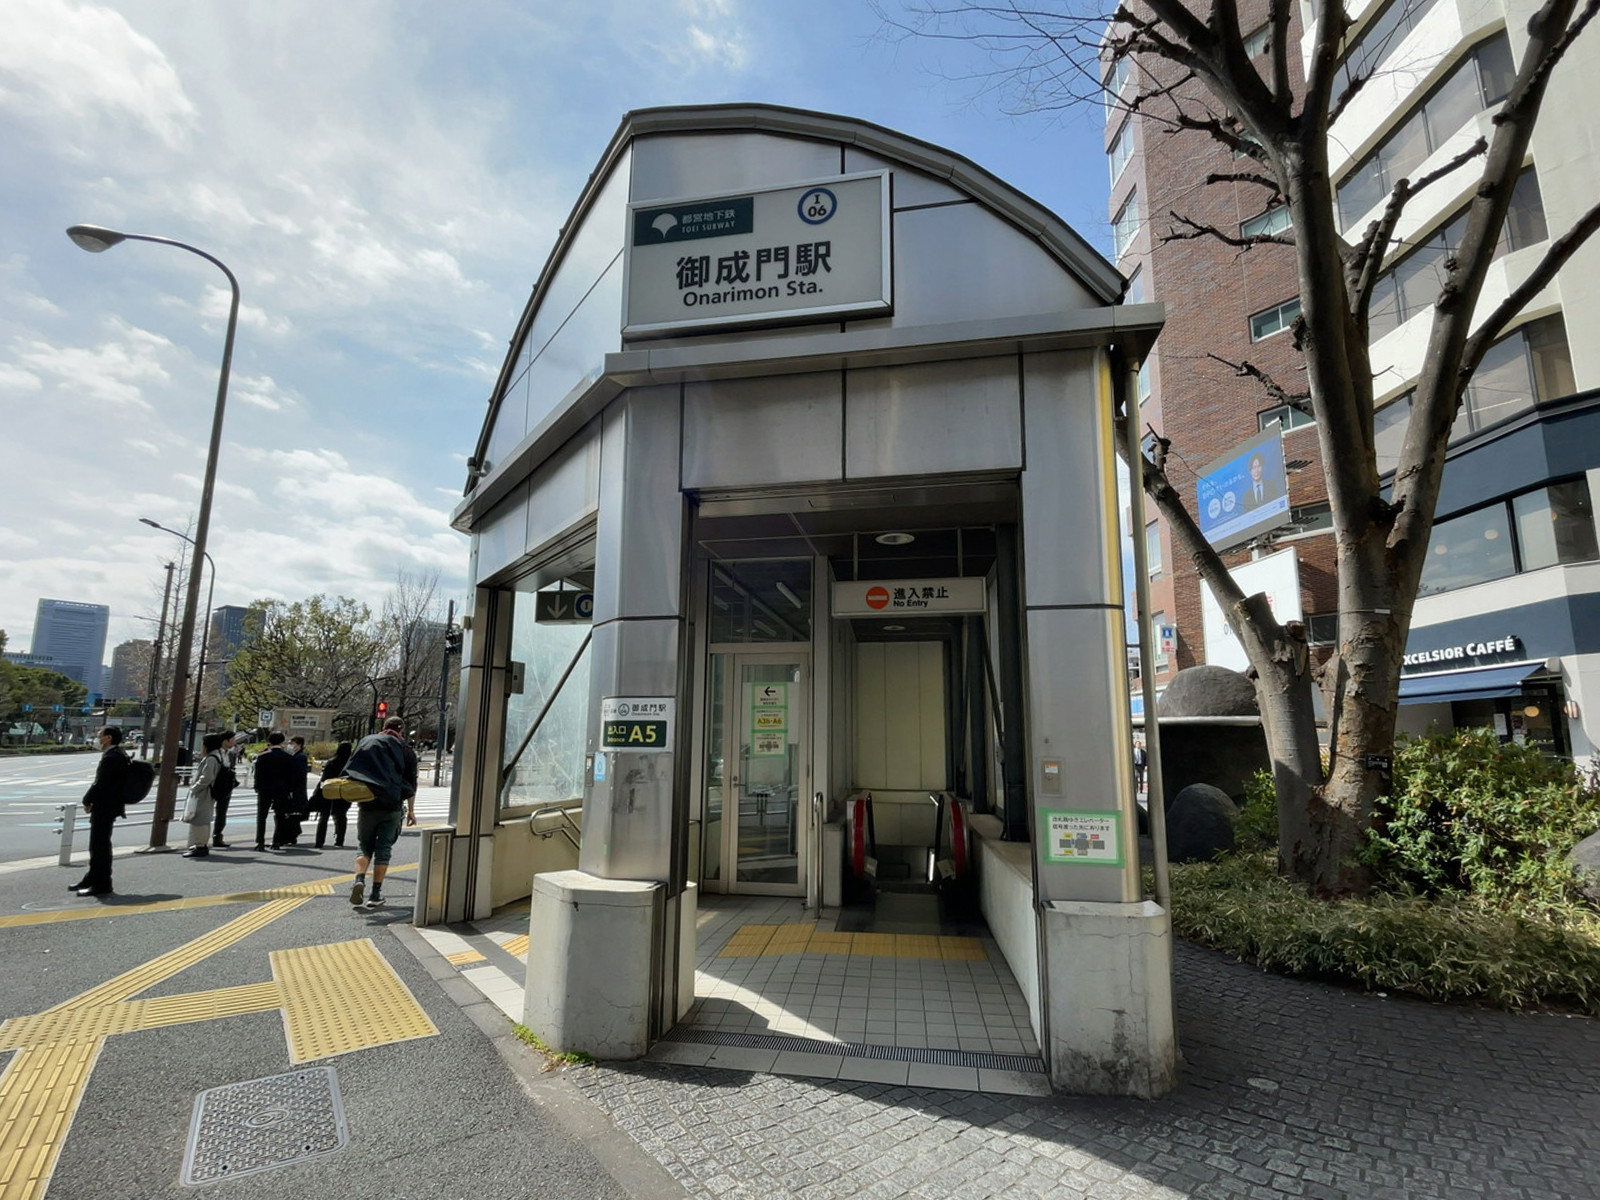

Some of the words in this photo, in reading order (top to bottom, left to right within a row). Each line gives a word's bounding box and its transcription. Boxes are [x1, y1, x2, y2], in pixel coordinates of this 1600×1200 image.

[682, 209, 736, 225] 都営地下鉄
[808, 204, 827, 218] 06
[682, 224, 700, 234] TOEI
[702, 221, 736, 231] SUBWAY
[676, 241, 832, 290] 御成門駅
[683, 285, 779, 307] Onarimon
[786, 280, 823, 297] Sta.
[894, 587, 949, 599] 進入禁止
[907, 600, 928, 608] Entry
[1403, 646, 1464, 666] XCELSIOR
[628, 725, 657, 743] A5
